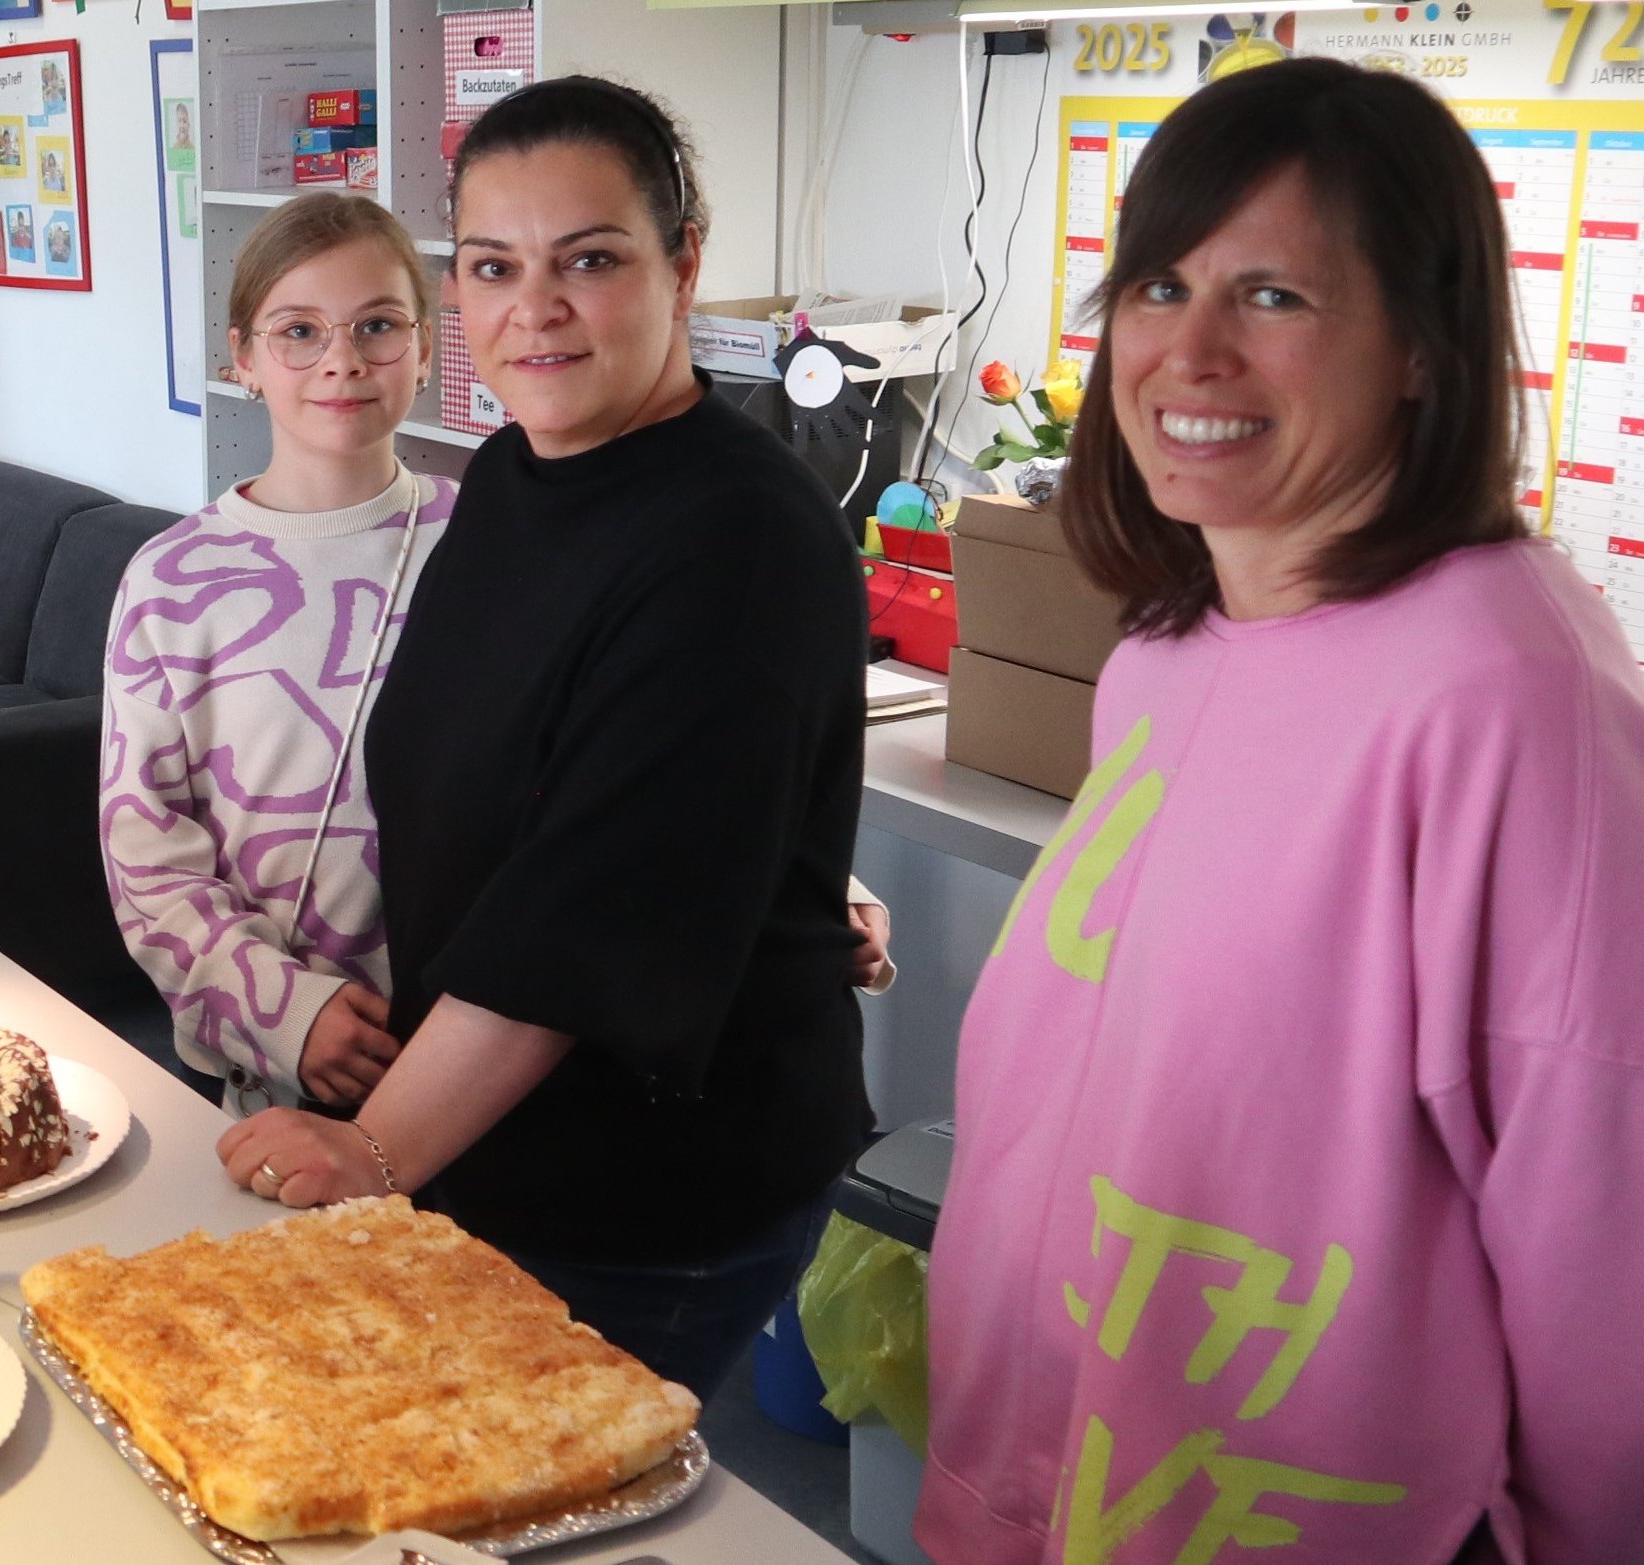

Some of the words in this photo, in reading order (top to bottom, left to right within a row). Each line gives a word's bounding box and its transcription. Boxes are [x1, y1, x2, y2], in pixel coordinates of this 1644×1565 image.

[1073, 22, 1172, 72] 2025
[1325, 34, 1404, 48] HERMANN
[1410, 33, 1455, 47] KLEIN
[1461, 32, 1512, 46] GMBH
[1421, 55, 1468, 77] 2025
[1589, 67, 1644, 84] JAHRE
[462, 78, 517, 93] Backzutaten
[316, 107, 337, 117] GALLI
[477, 394, 495, 412] Tee
[1062, 1174, 1354, 1421] TH
